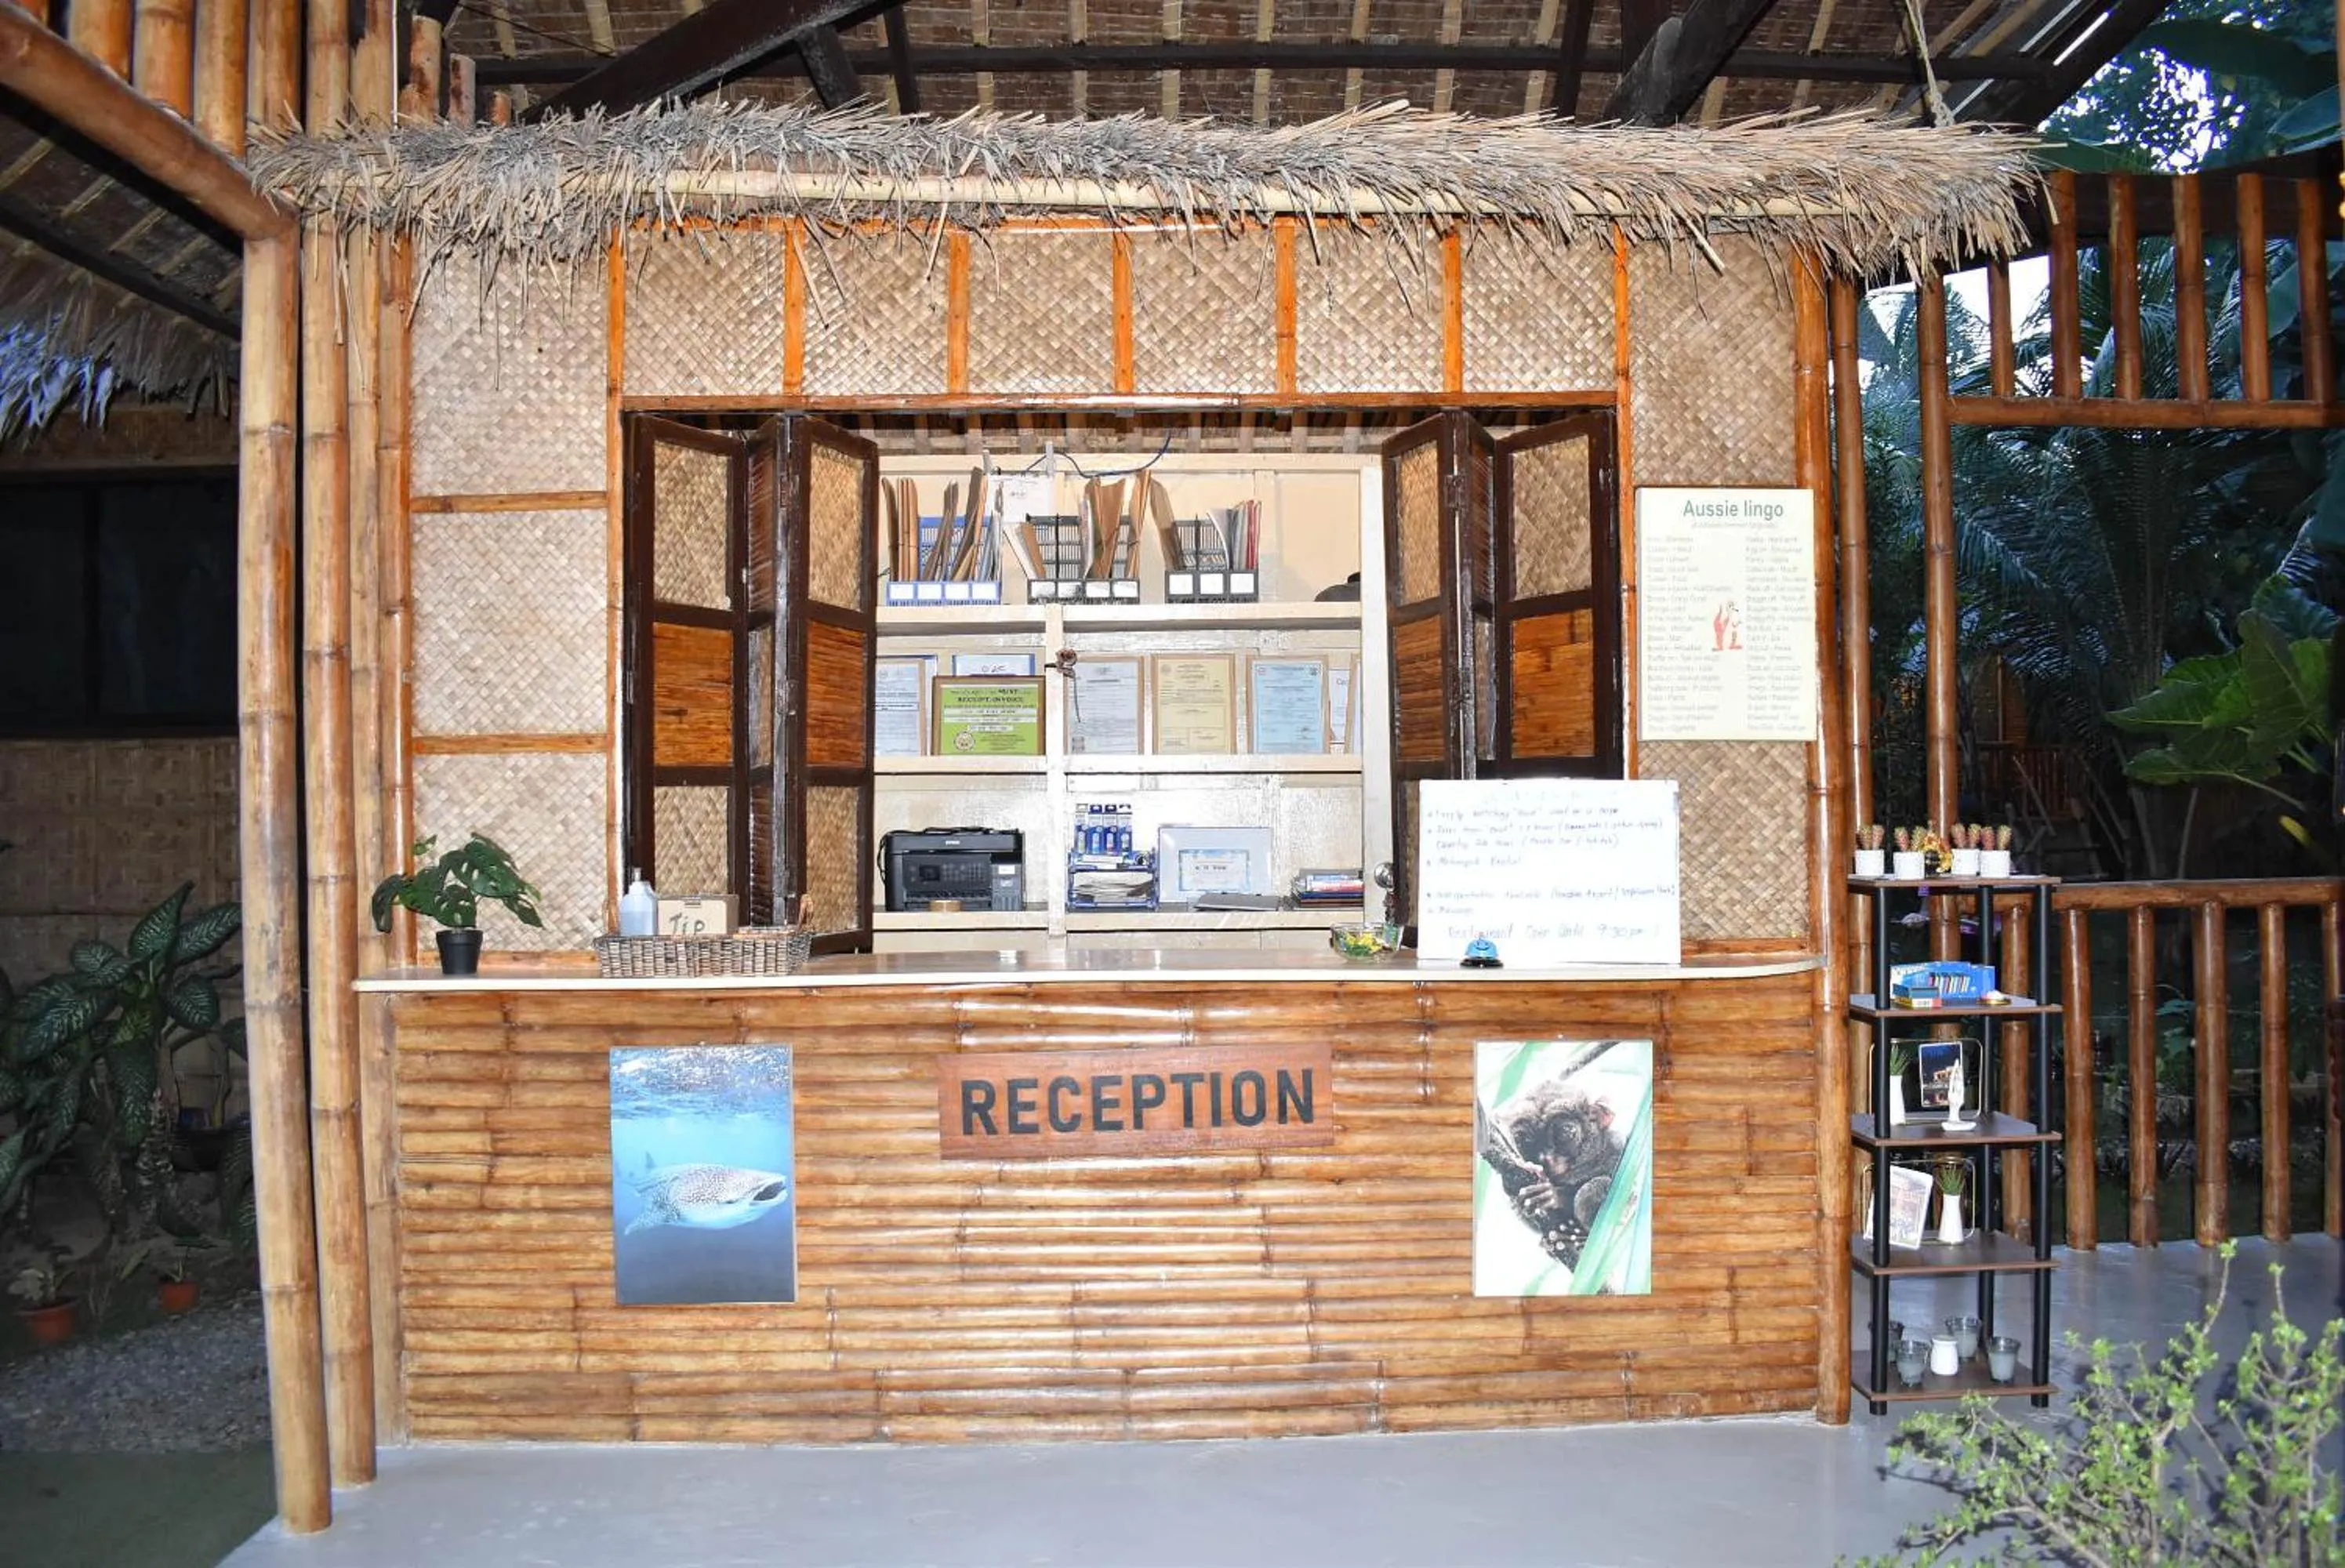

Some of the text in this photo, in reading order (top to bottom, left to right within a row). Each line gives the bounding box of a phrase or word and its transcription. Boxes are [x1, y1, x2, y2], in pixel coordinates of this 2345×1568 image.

[1683, 499, 1784, 521] Aussie lingo
[669, 912, 706, 935] Tip
[961, 1069, 1314, 1135] RECEPTION
